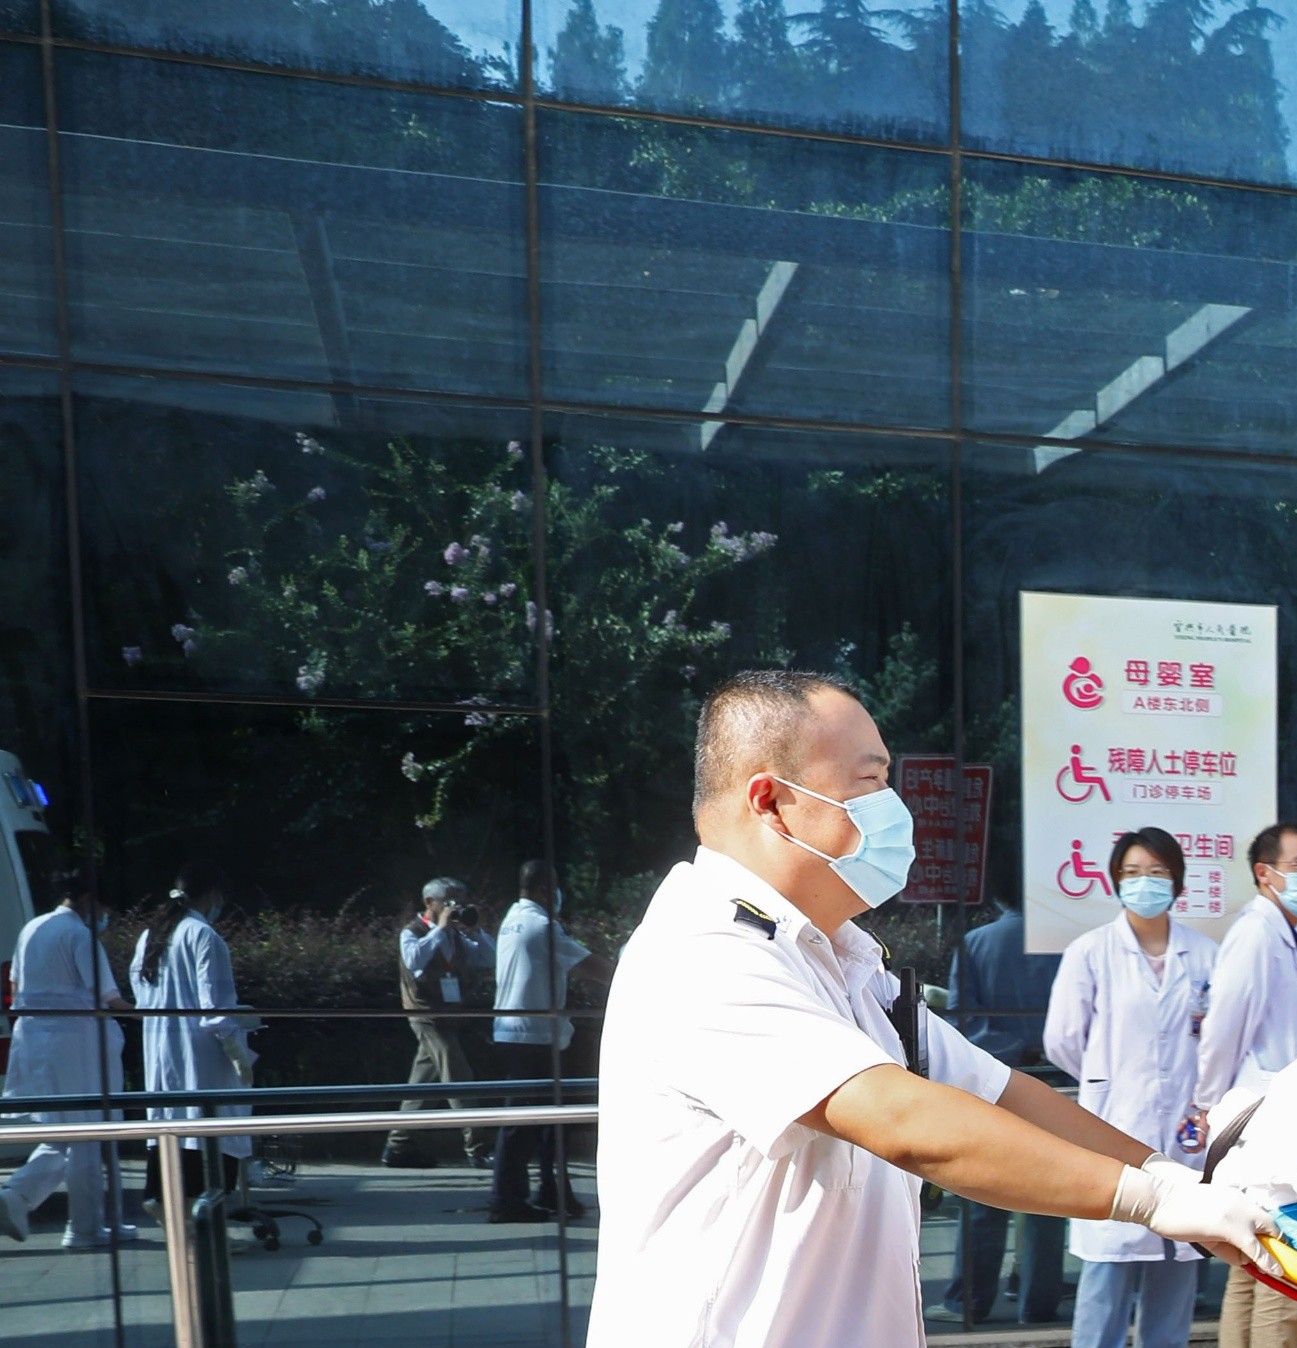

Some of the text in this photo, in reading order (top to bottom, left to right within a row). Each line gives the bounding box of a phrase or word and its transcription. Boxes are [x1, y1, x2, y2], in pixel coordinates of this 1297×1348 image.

[1124, 659, 1215, 689] 母婴室
[1132, 696, 1211, 713] A楼东北侧
[1107, 747, 1237, 778] 残障人士停车位
[1132, 784, 1212, 801] 门诊停车场
